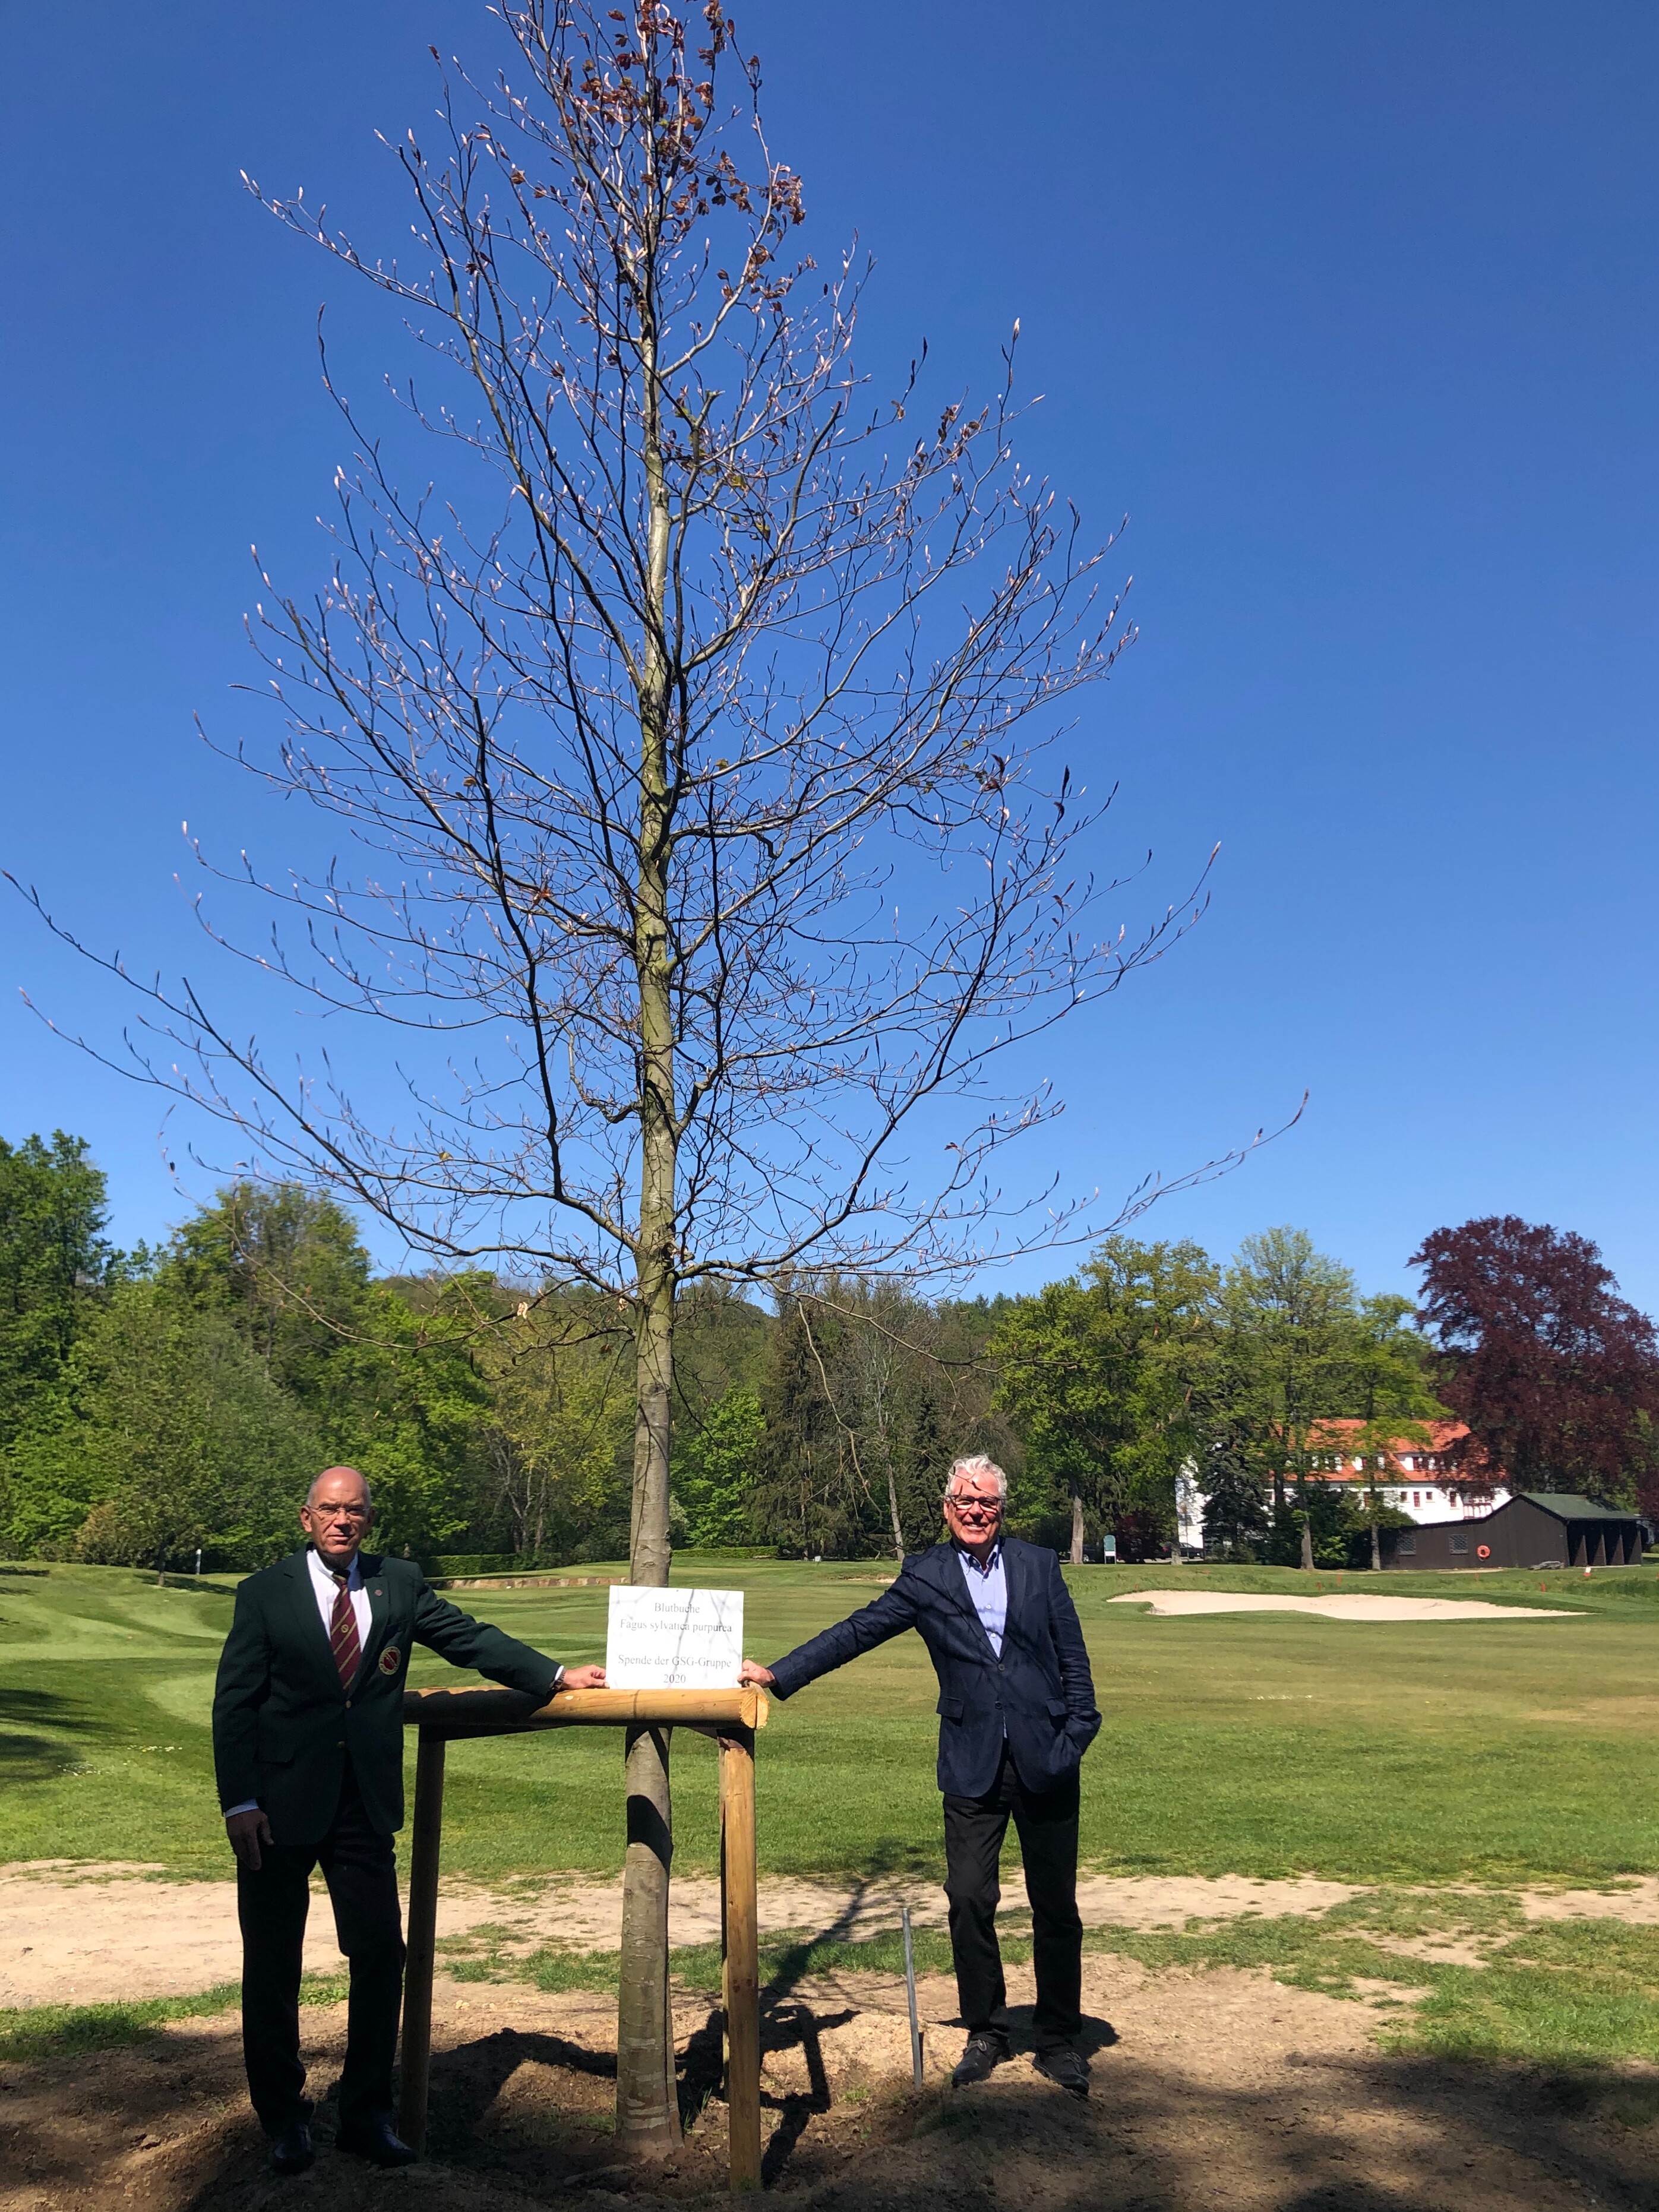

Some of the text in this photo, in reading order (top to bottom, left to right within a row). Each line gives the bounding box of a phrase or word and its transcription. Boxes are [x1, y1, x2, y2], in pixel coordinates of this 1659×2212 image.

[655, 1603, 700, 1613] Blutbuche
[620, 1619, 732, 1633] Fagus sylvatica purpurea
[618, 1655, 731, 1668] Spende der GSG-Gruppe
[663, 1674, 686, 1683] 2020
